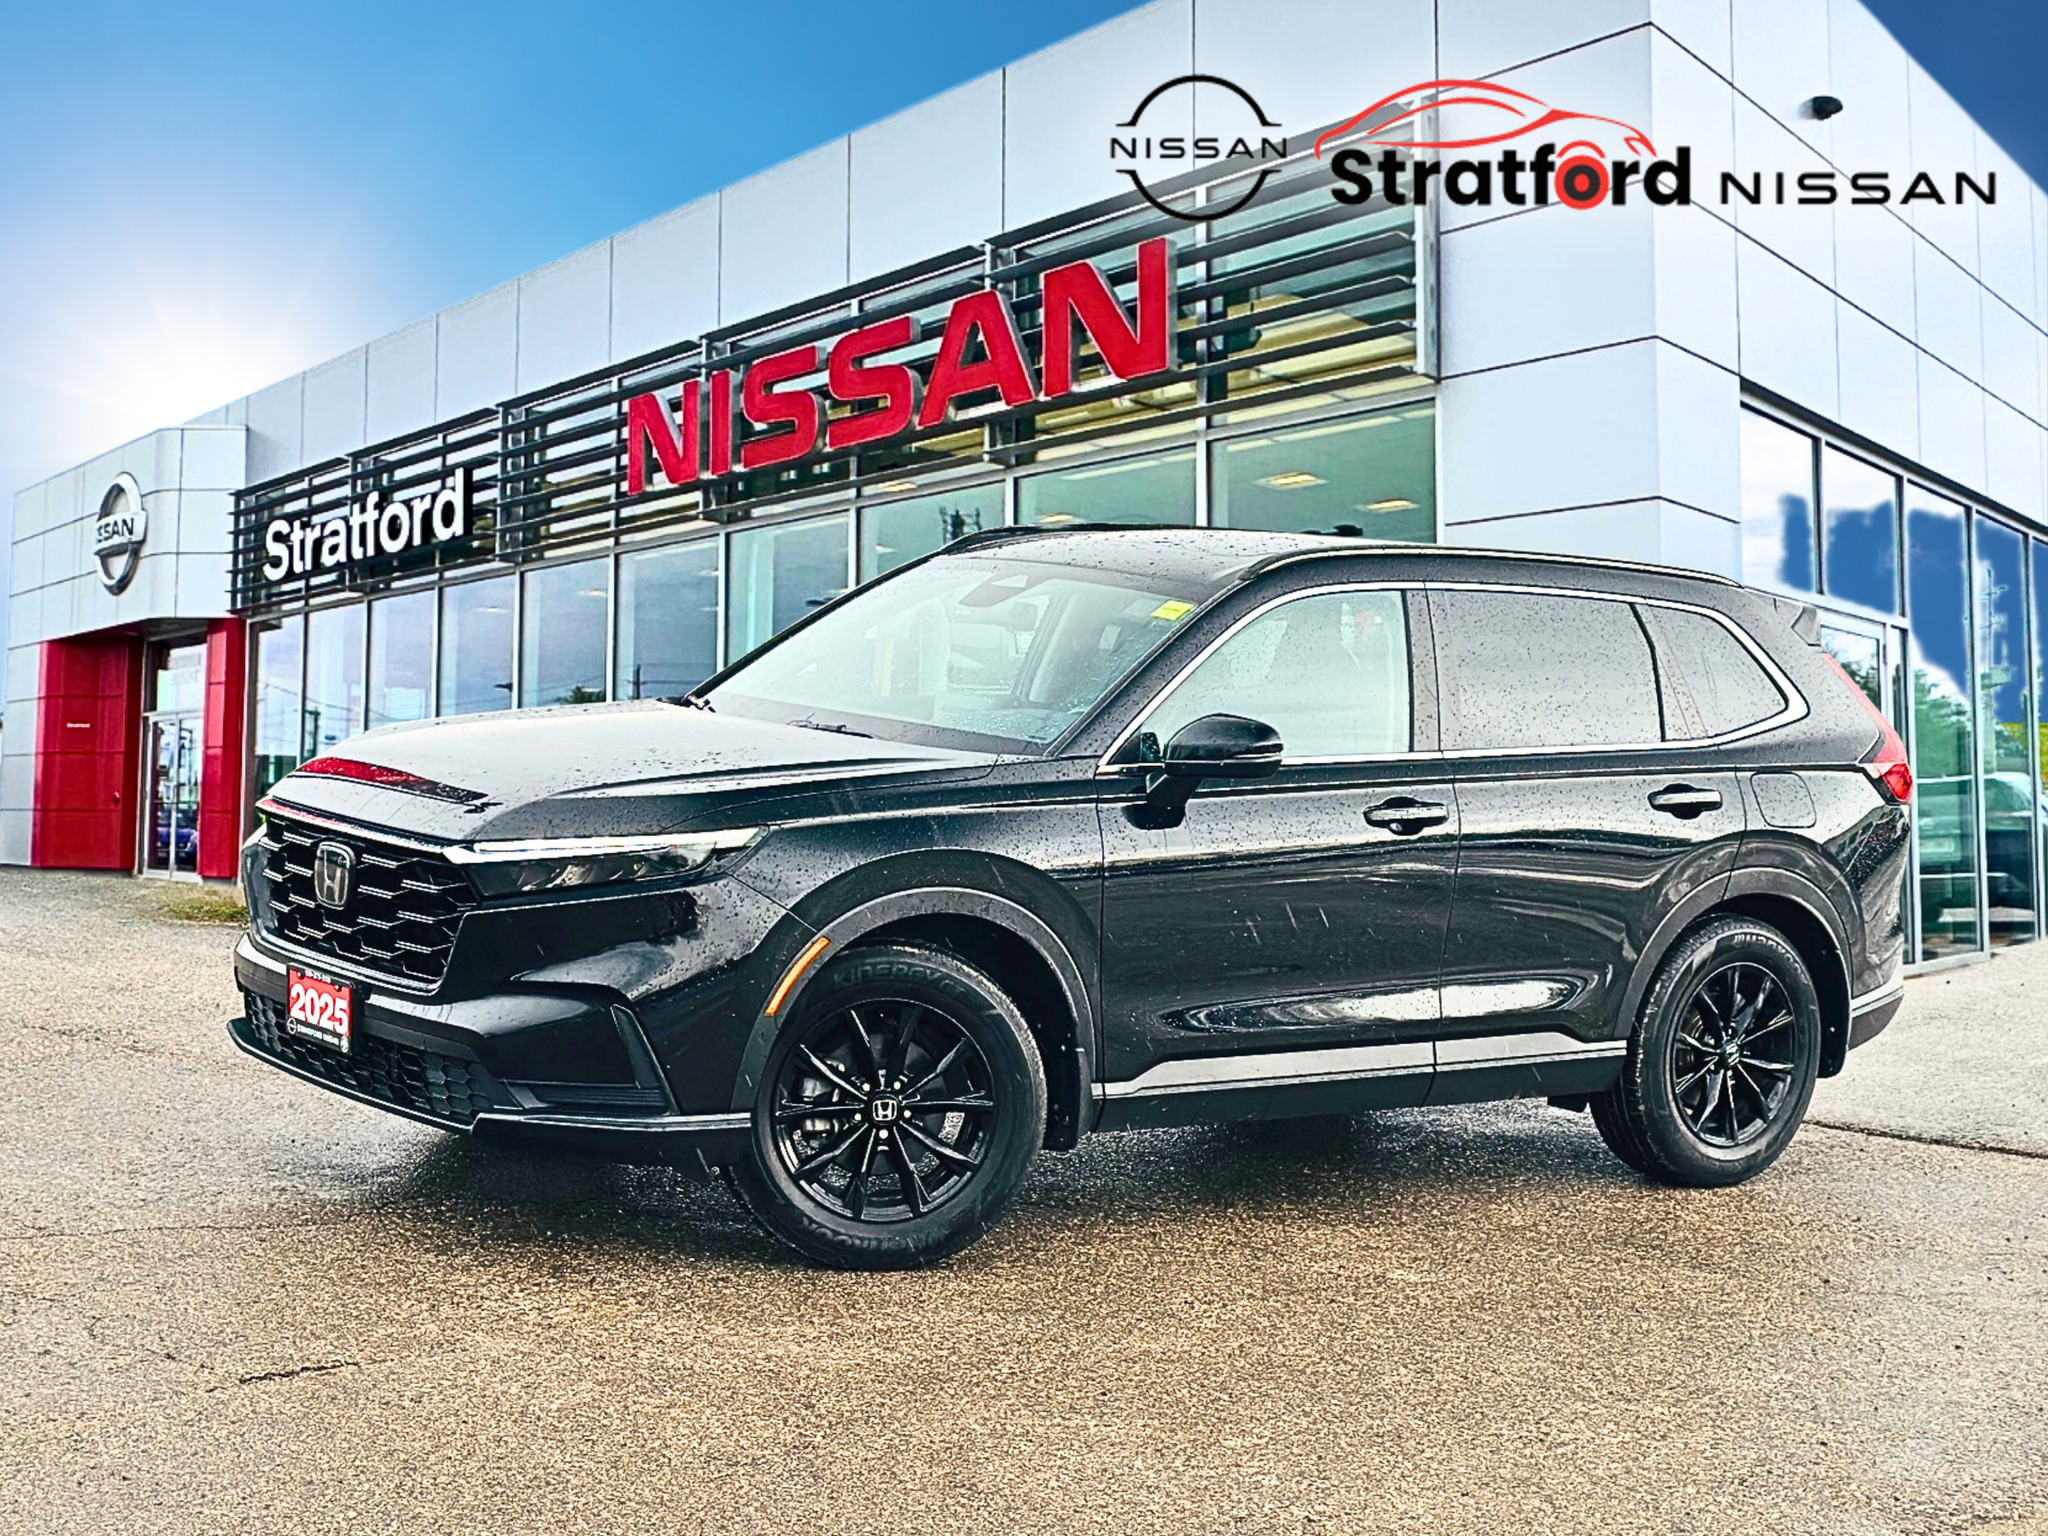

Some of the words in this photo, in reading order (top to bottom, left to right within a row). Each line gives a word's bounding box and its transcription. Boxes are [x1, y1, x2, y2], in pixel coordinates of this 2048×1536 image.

[627, 237, 1176, 496] NISSAN
[262, 466, 465, 582] Stratford
[289, 982, 349, 1035] 2025
